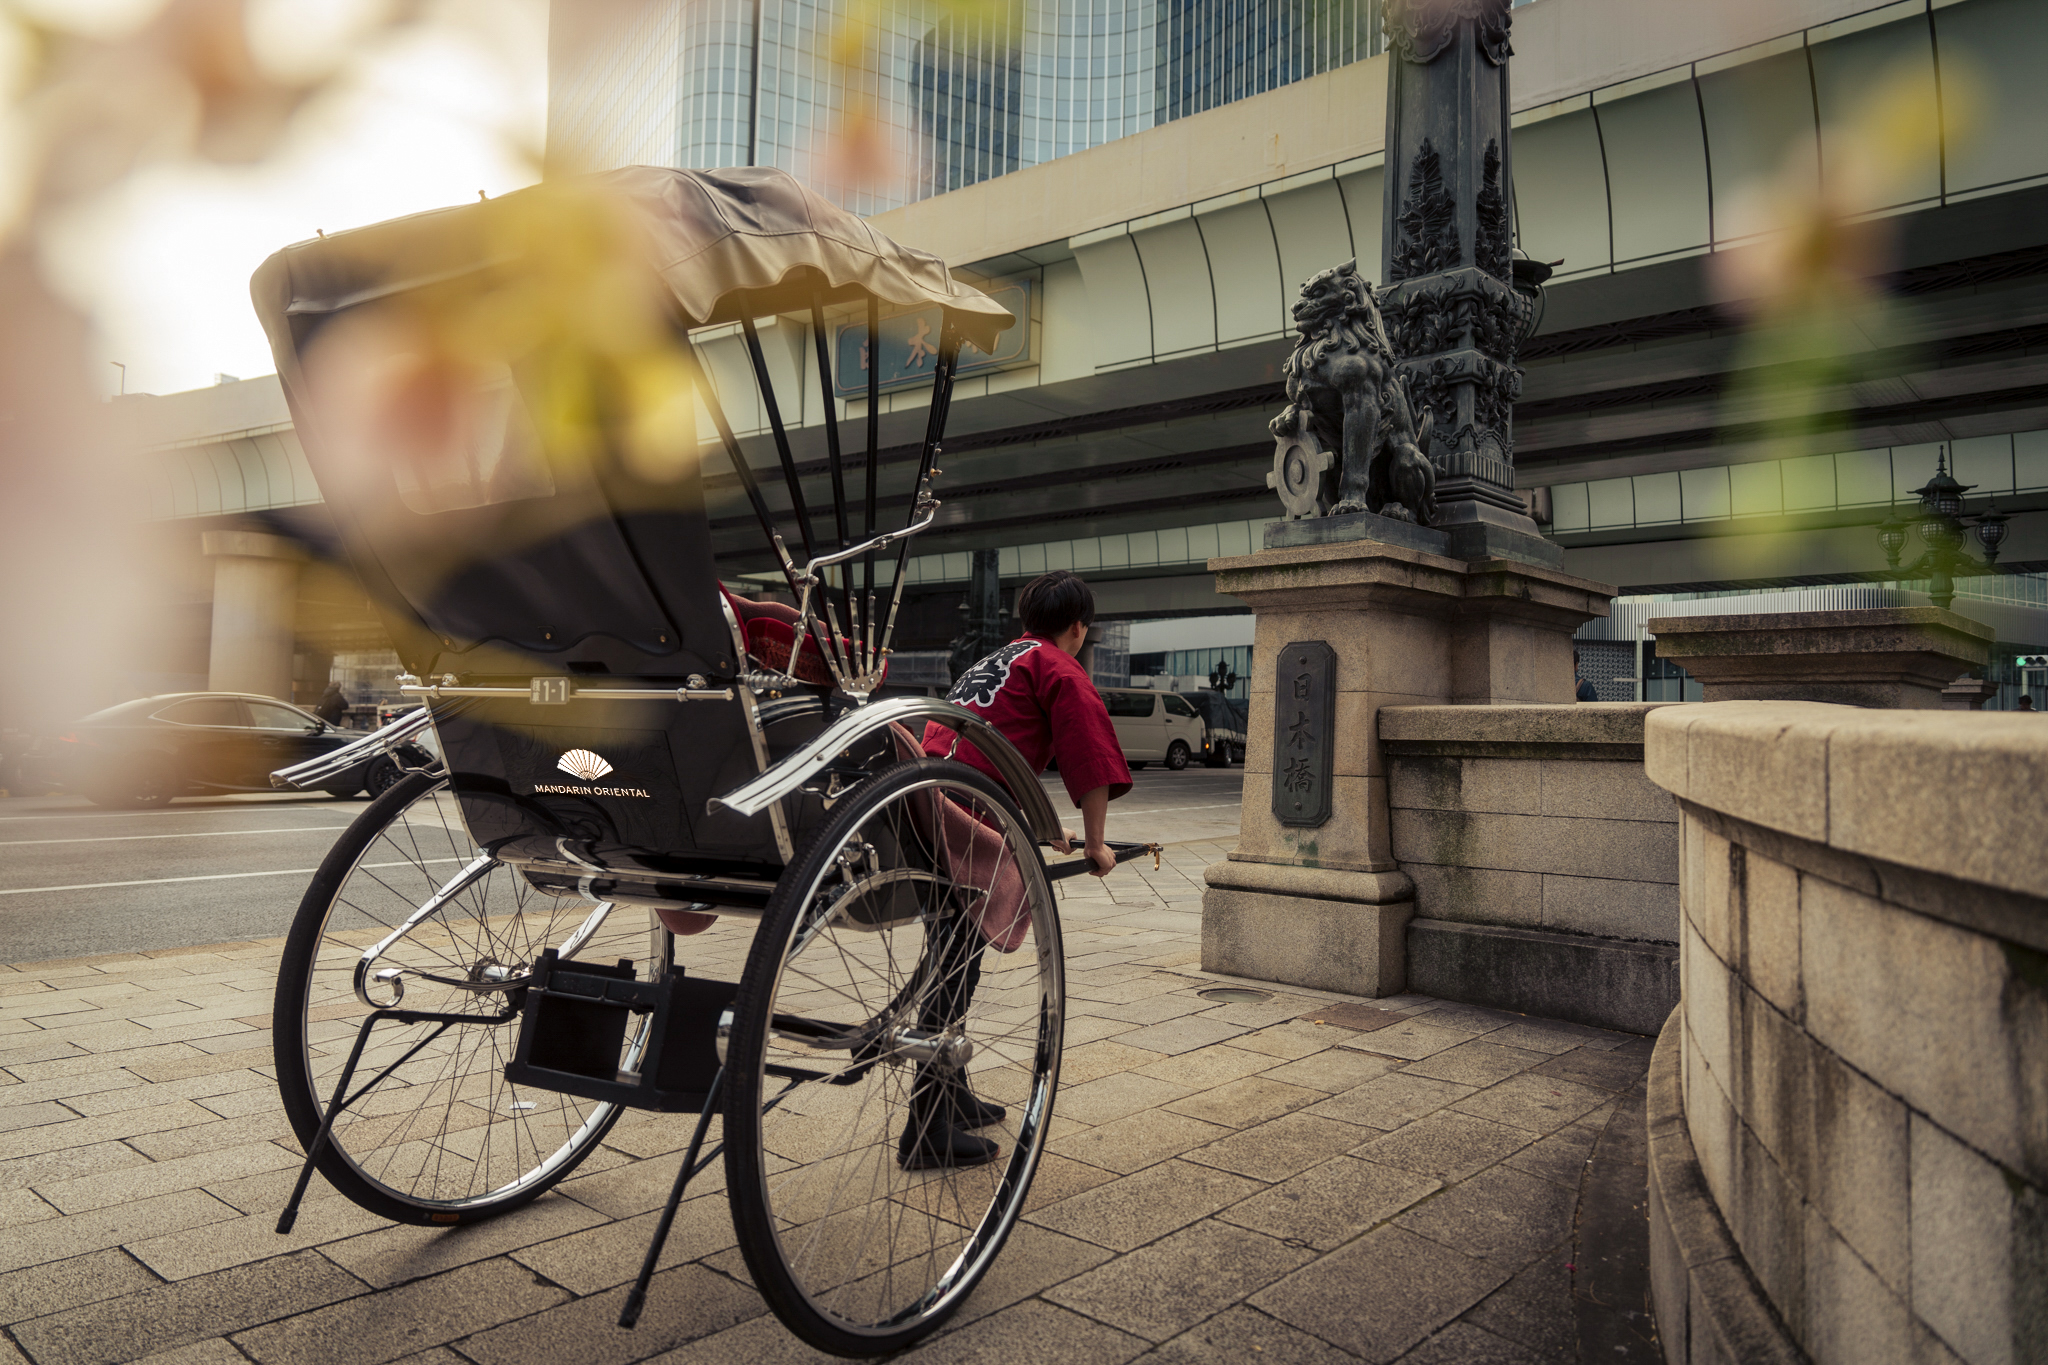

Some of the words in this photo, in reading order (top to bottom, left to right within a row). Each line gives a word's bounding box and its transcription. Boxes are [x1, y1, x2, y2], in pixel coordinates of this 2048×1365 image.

[1283, 672, 1317, 794] 日本橋
[534, 784, 592, 796] MANDARIN
[593, 786, 651, 798] ORIENTAL
